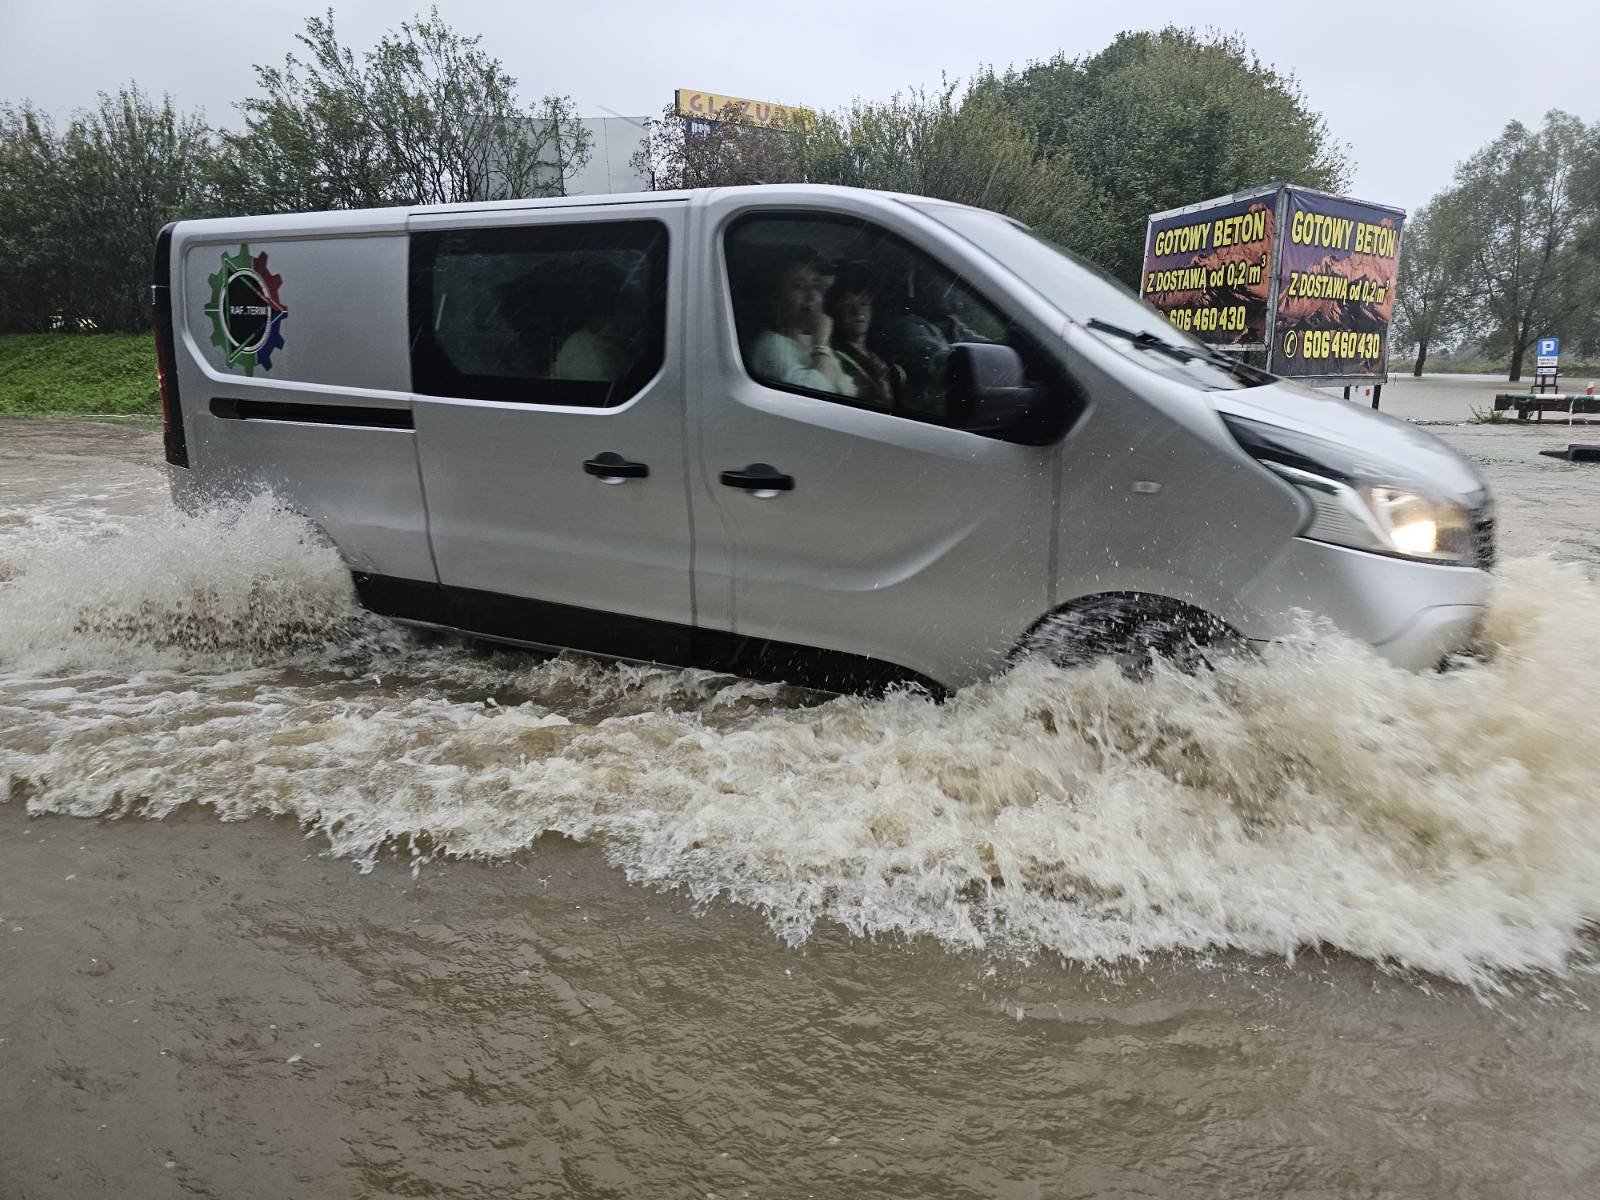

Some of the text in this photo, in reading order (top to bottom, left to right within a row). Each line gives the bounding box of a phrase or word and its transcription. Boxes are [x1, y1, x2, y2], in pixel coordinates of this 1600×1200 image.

[1155, 210, 1266, 256] GOTOWY BETON
[1292, 211, 1396, 257] GOTOWY BETON
[1147, 273, 1155, 292] Z
[1156, 268, 1207, 293] DOSTAWĄ
[1210, 265, 1225, 287] od
[1227, 261, 1246, 289] 0,2
[1289, 273, 1298, 295] Z
[1299, 274, 1347, 305] DOSTAWĄ
[1349, 280, 1362, 300] od
[1363, 284, 1376, 305] 0,2
[1170, 306, 1246, 331] 606 460 430
[1303, 330, 1380, 359] 606 460 430
[1542, 340, 1555, 355] P
